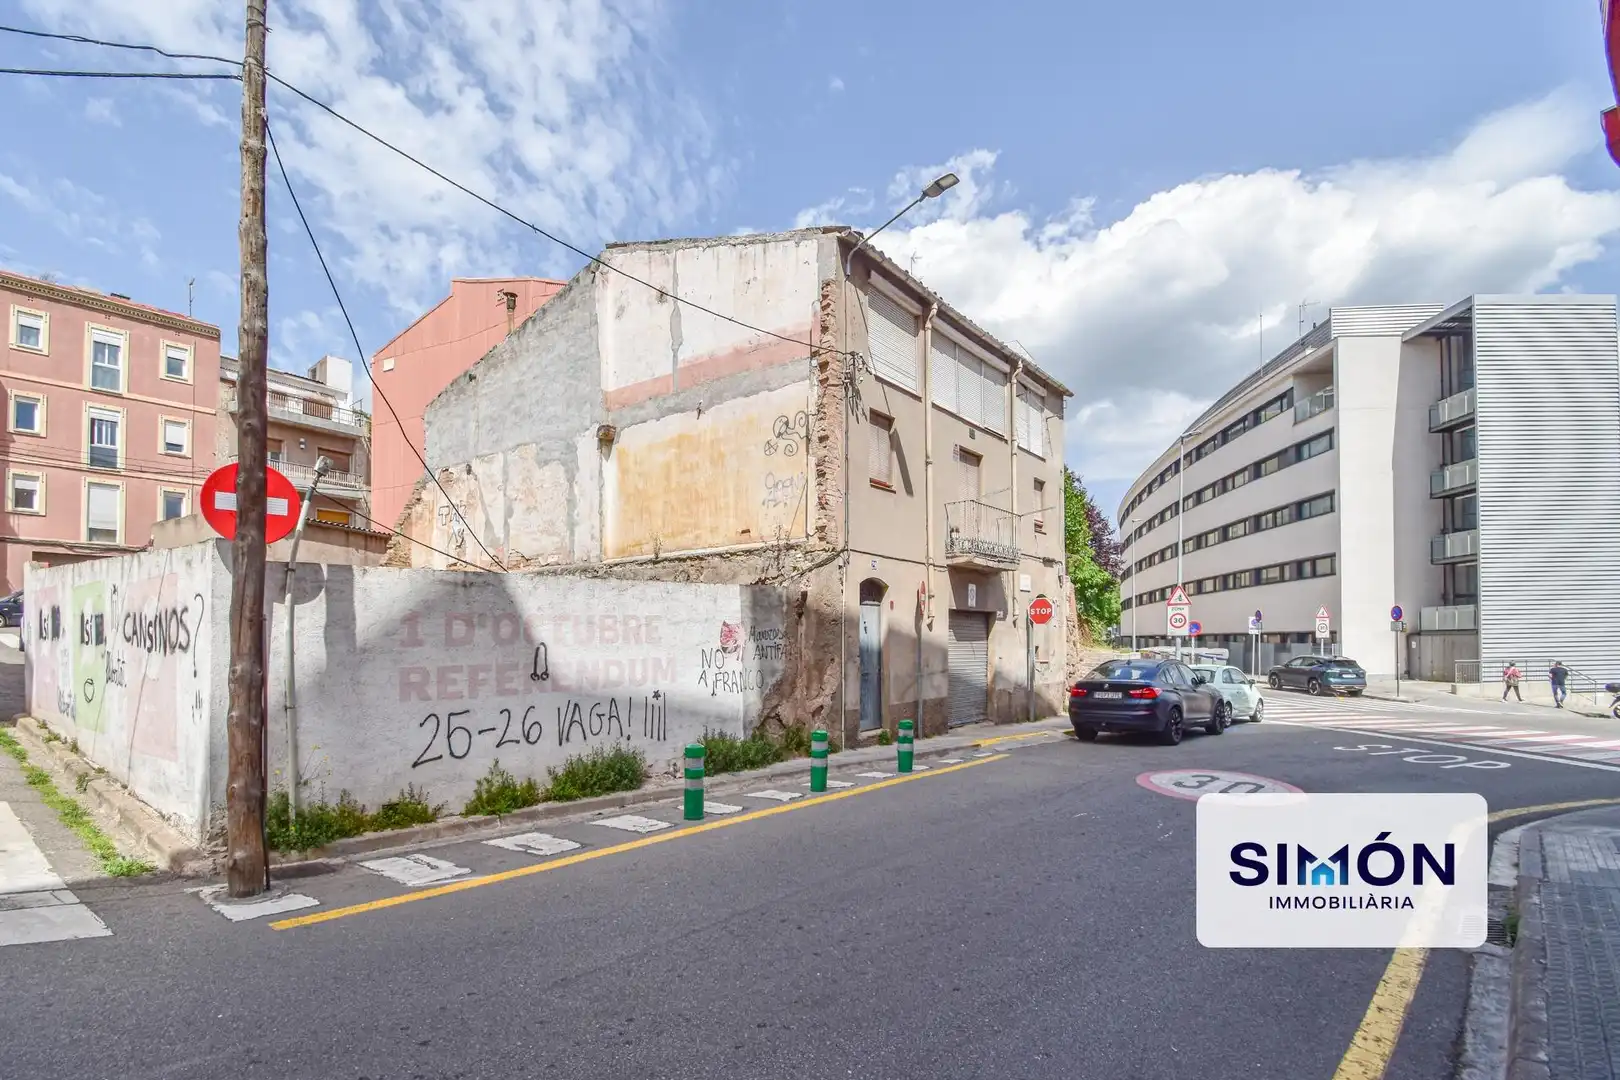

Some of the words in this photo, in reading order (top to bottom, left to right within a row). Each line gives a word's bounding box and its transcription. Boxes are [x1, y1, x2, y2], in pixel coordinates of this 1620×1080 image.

[1030, 607, 1051, 615] STOP
[443, 612, 664, 648] D'OCTUBRE
[701, 648, 725, 669] NO
[400, 655, 677, 701] REFERENDUM
[411, 705, 543, 769] 25-26
[557, 696, 633, 747] VAGA!
[1333, 743, 1512, 770] STOP
